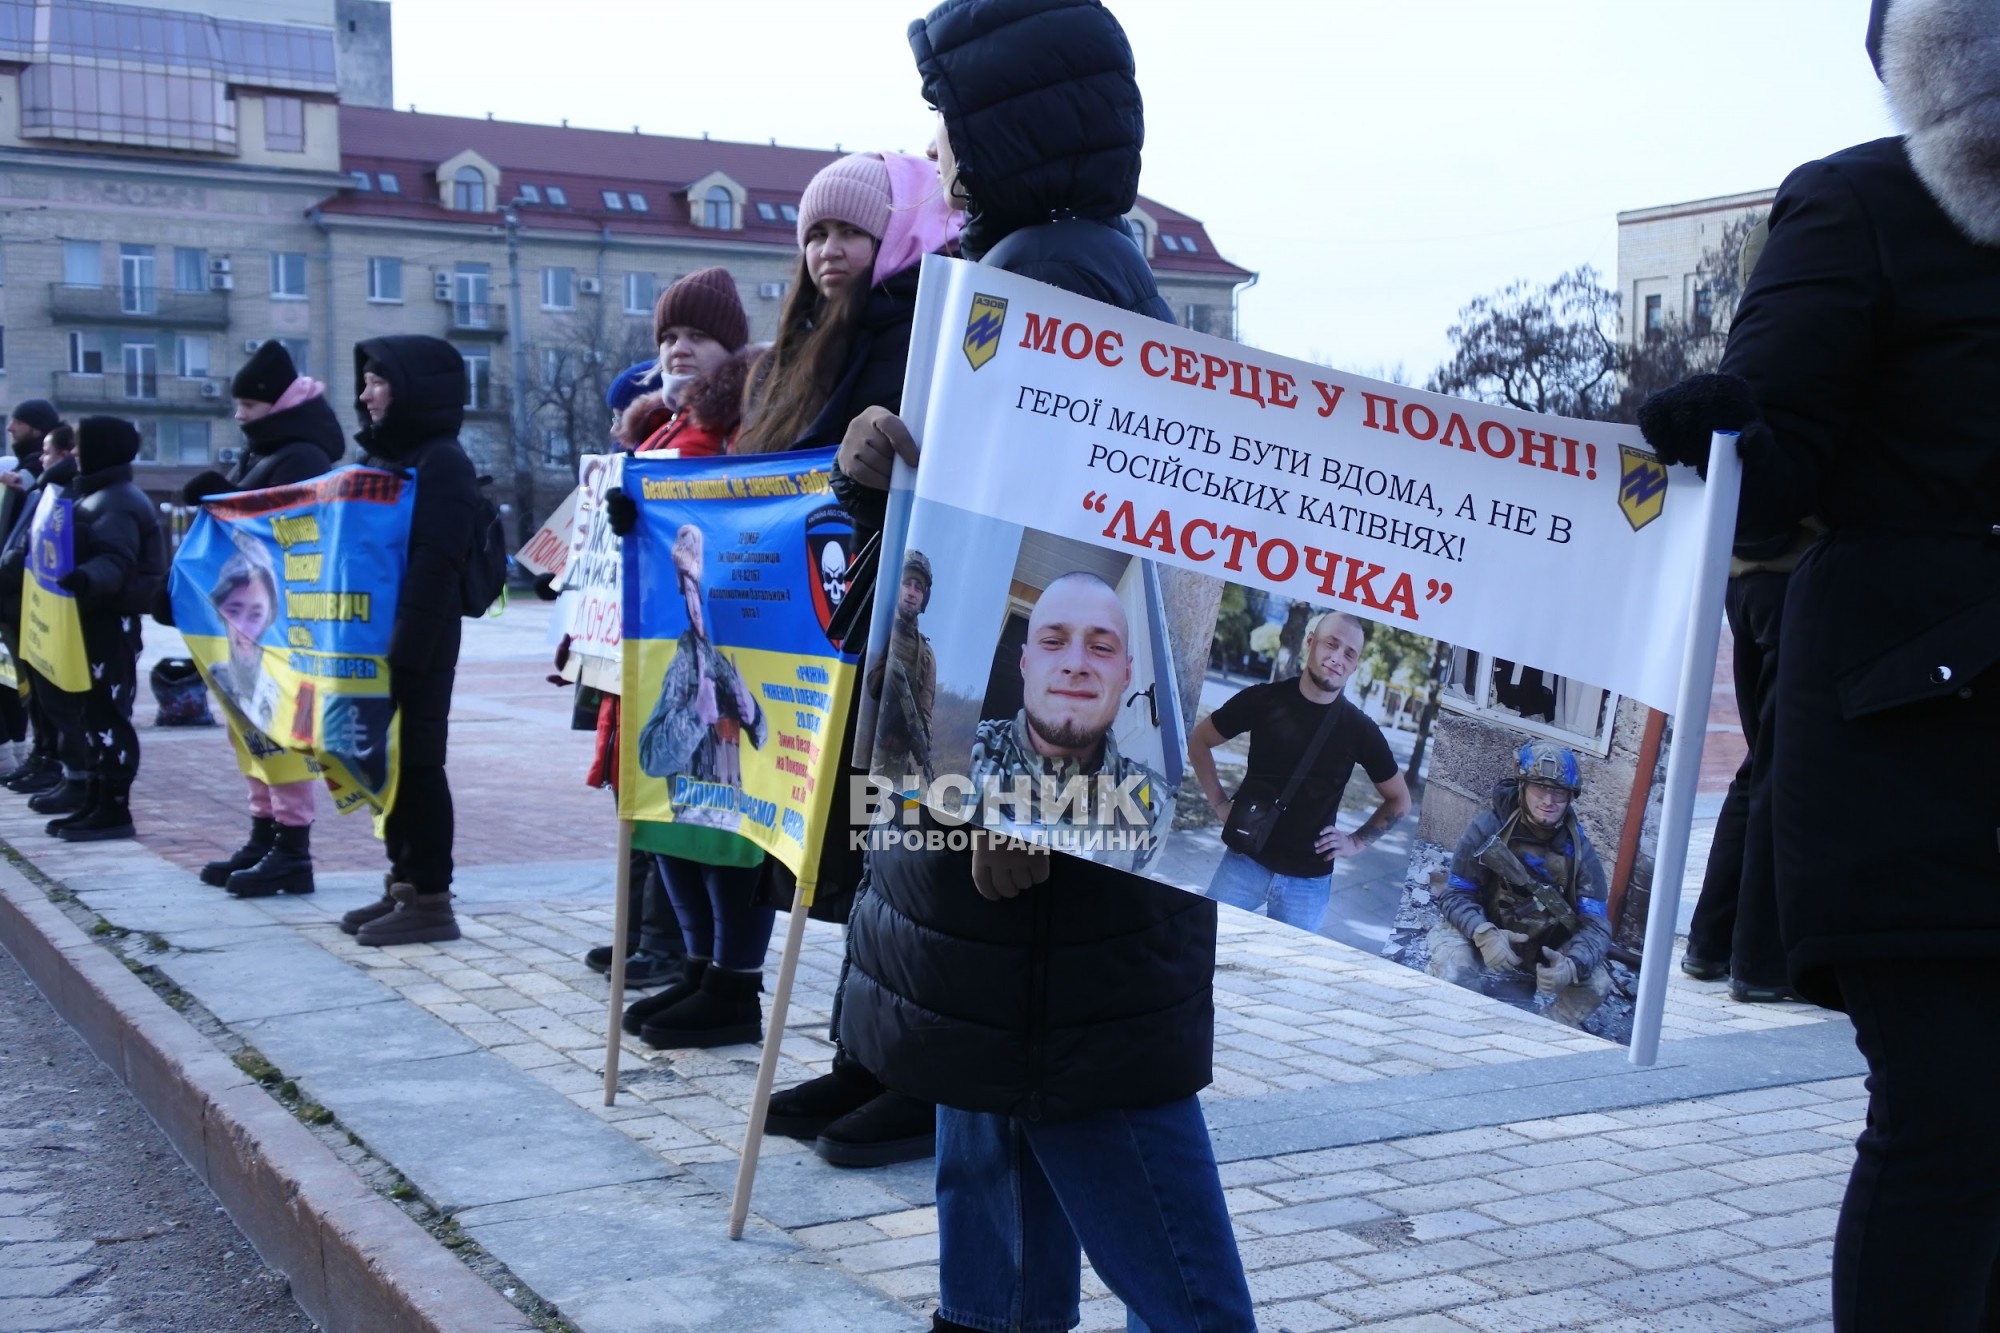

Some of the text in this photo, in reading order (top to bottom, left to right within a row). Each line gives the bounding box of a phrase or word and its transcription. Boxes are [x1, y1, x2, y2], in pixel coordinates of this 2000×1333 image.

[976, 298, 1005, 310] АЗОВ
[1019, 312, 1597, 481] МОЄ СЕРЦЕ У ПОЛОНІ!
[795, 468, 833, 496] забу
[1015, 385, 1573, 544] ГЕРОЇ МАЮТЬ БУТИ ВДОМА, А НЕ В
[1087, 443, 1467, 563] РОСІЙСЬКИХ КАТІВНЯХ!
